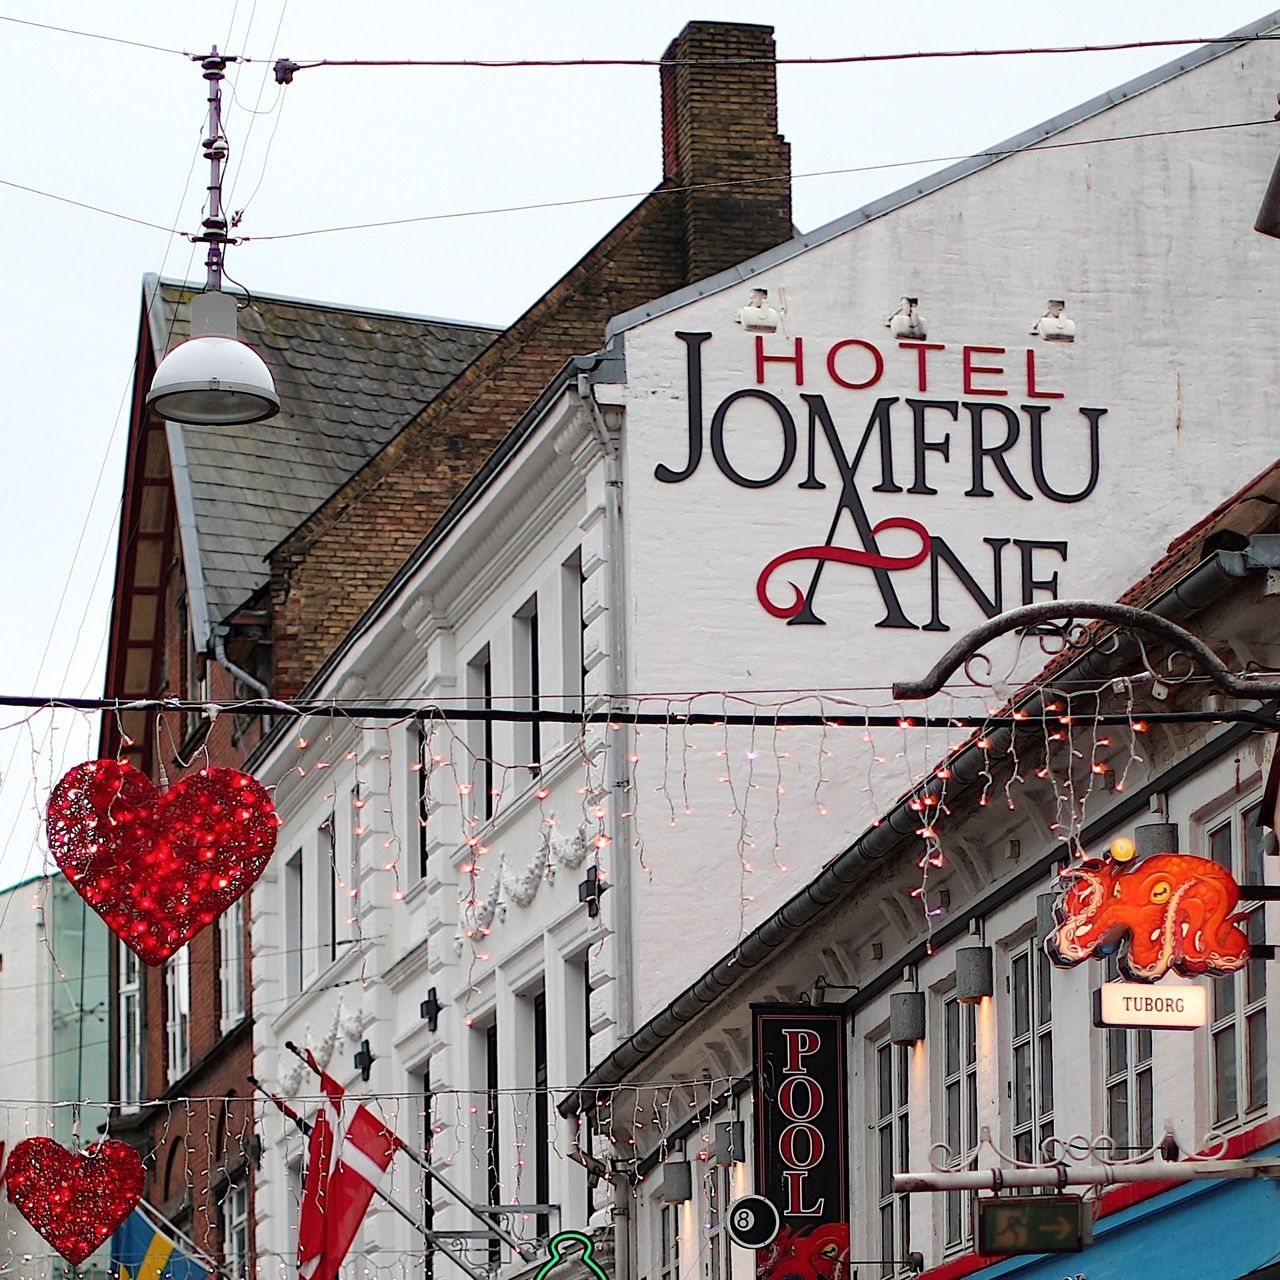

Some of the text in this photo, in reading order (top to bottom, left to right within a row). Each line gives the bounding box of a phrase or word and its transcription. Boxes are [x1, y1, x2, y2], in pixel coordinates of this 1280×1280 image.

[654, 330, 1108, 504] JOMFRU
[755, 335, 1065, 398] HOTEL
[756, 478, 1069, 637] ANE
[1122, 996, 1186, 1013] TUBORG
[777, 1027, 825, 1217] POOL
